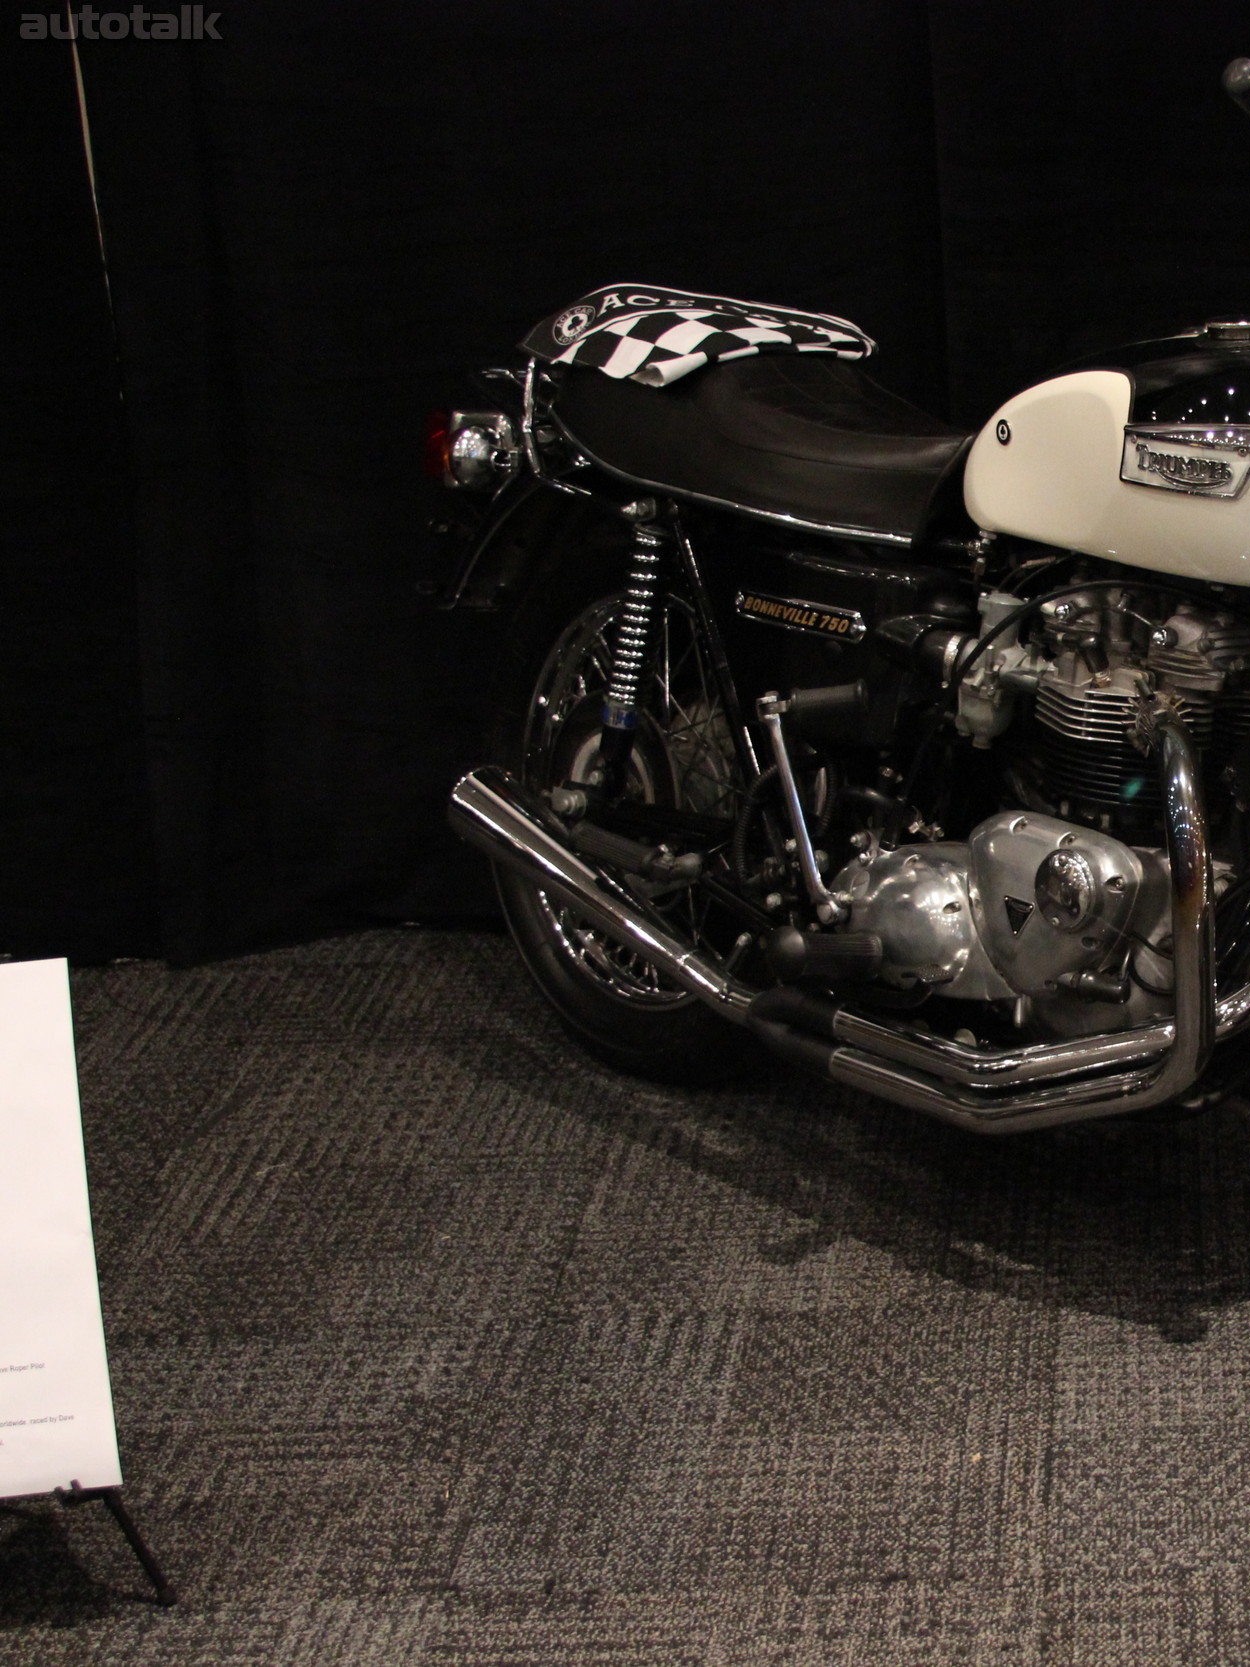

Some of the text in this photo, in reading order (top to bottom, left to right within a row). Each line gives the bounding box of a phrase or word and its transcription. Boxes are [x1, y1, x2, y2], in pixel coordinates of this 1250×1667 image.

[596, 293, 695, 318] ACE
[1136, 443, 1233, 482] TRIUMPH
[743, 596, 850, 633] BONNEVILLE 750
